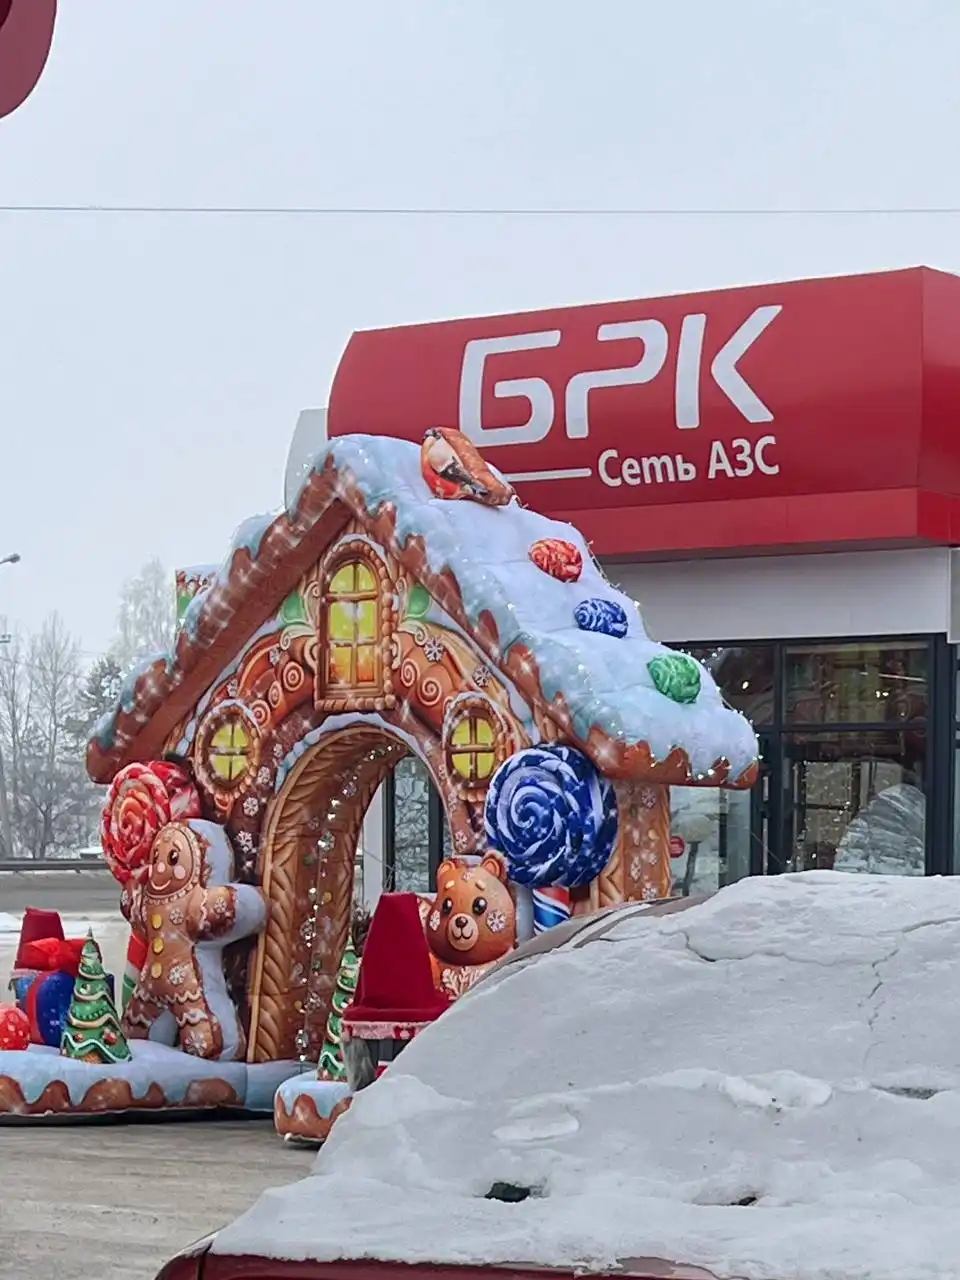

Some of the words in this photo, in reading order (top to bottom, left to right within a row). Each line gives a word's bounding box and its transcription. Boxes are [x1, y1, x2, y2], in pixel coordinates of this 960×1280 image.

[458, 305, 783, 447] БРК
[597, 448, 697, 488] Сеть
[707, 434, 780, 478] АЗС
